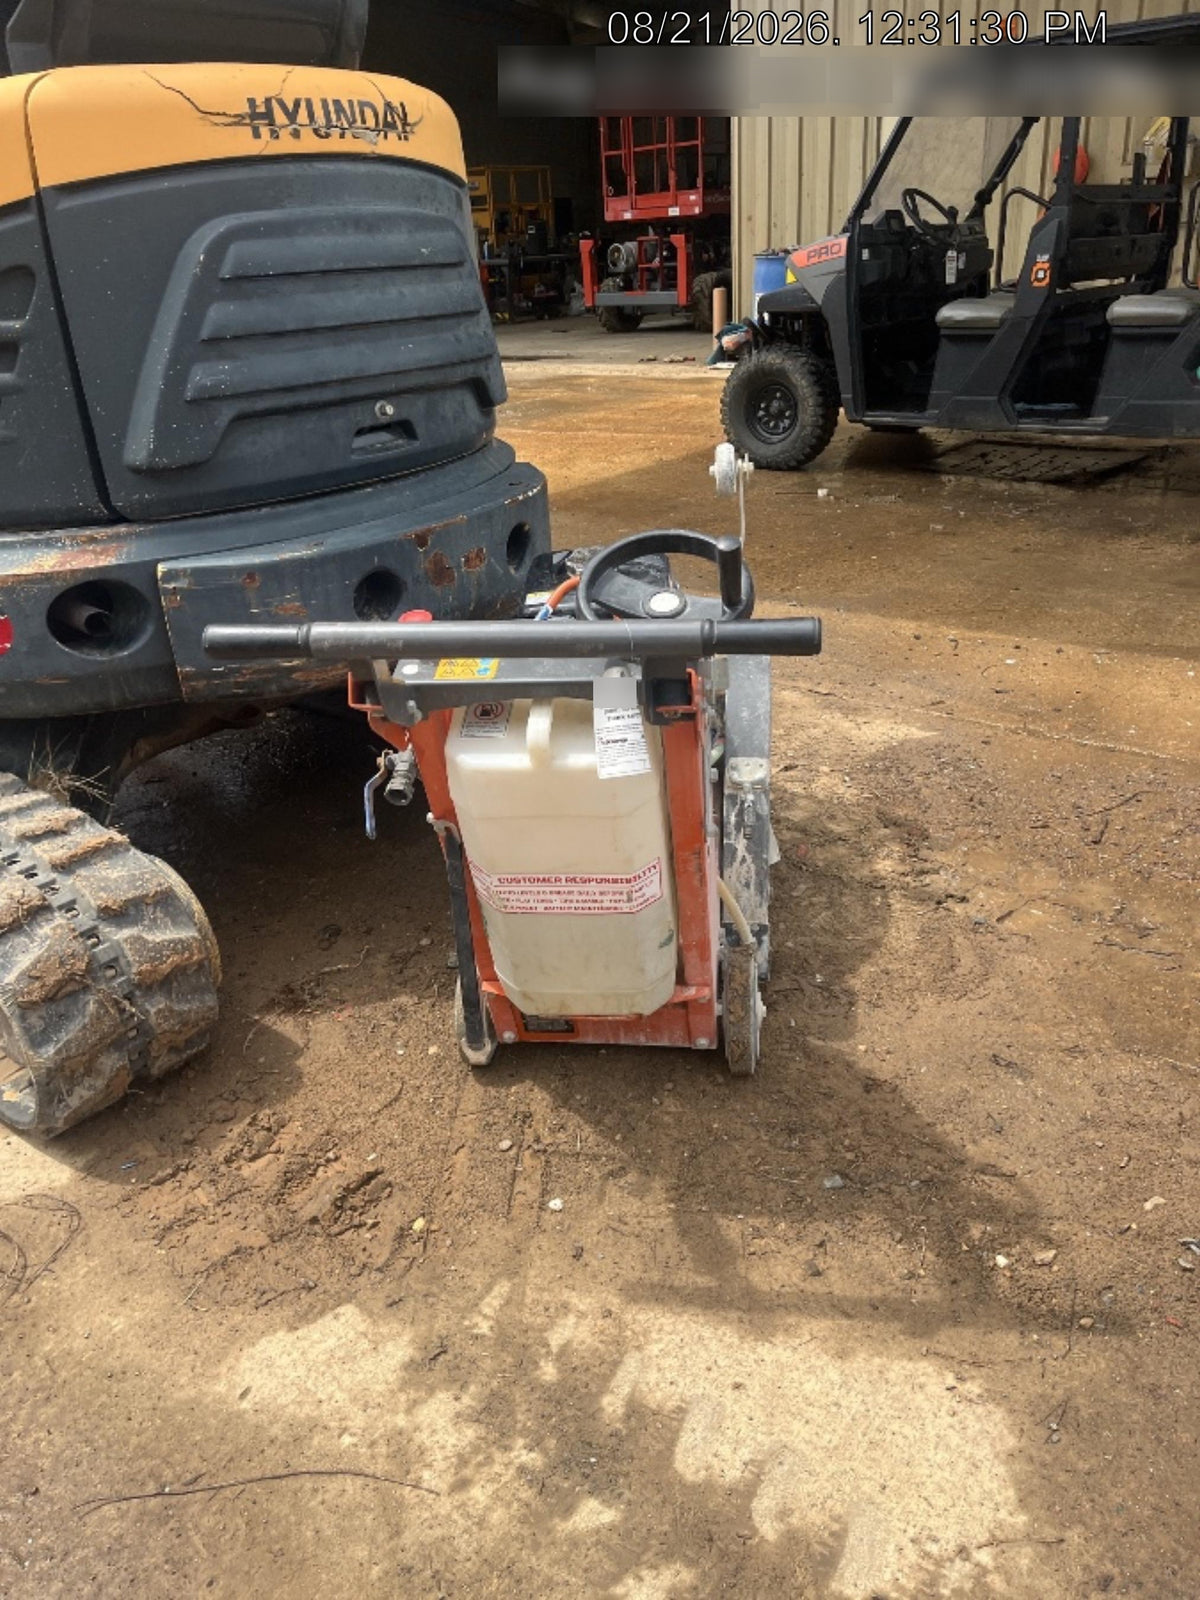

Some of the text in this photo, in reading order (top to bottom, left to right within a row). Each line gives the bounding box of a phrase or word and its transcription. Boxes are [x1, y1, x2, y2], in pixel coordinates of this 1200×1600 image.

[246, 97, 409, 141] HYUNDAI
[806, 243, 842, 263] PRO
[497, 864, 658, 885] CUSTOMER RESPONSIBILITY
